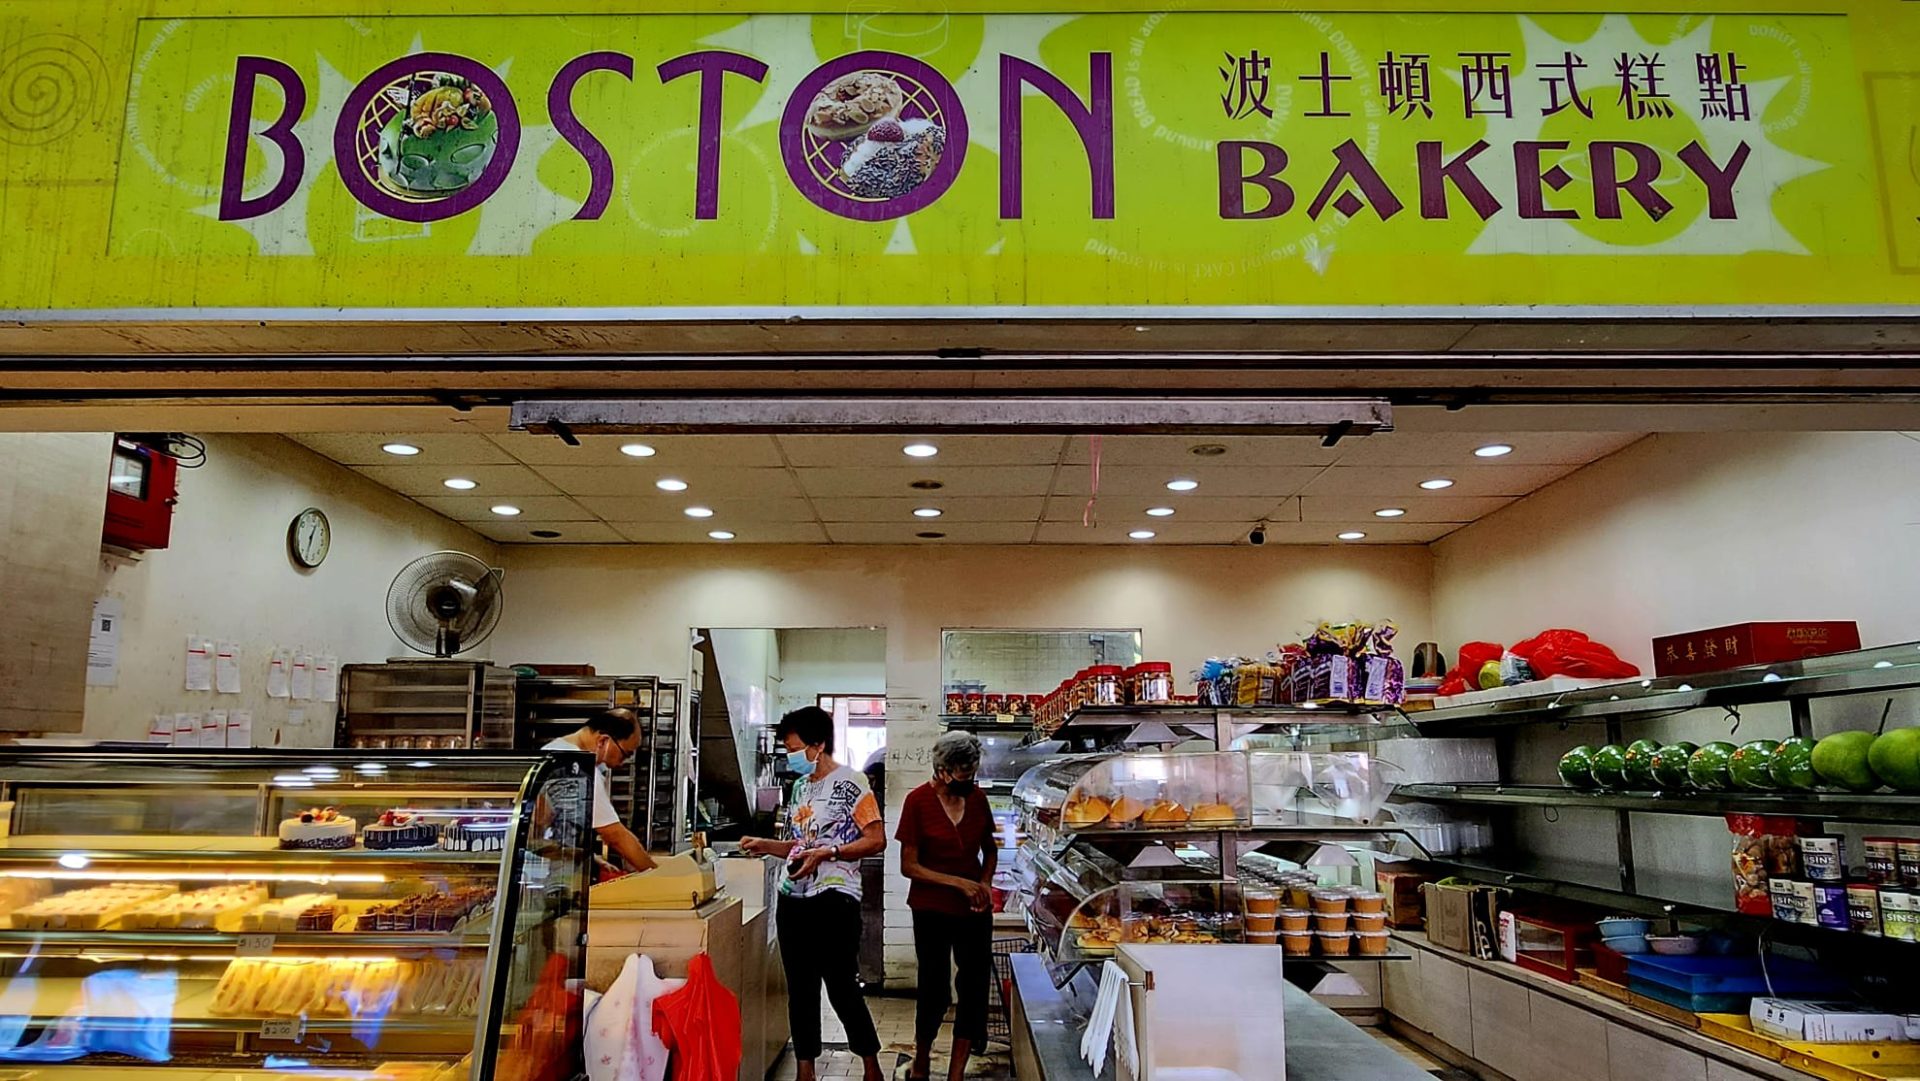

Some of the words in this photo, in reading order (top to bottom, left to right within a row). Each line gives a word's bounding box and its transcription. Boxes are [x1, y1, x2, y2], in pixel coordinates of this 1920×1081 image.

[1129, 36, 1146, 57] all
[1328, 30, 1371, 80] DONUT
[1124, 76, 1156, 129] BREAD
[1219, 50, 1751, 121] 波士頓西式糕點
[220, 53, 1116, 221] BOSTON
[1216, 138, 1752, 222] BAKERY
